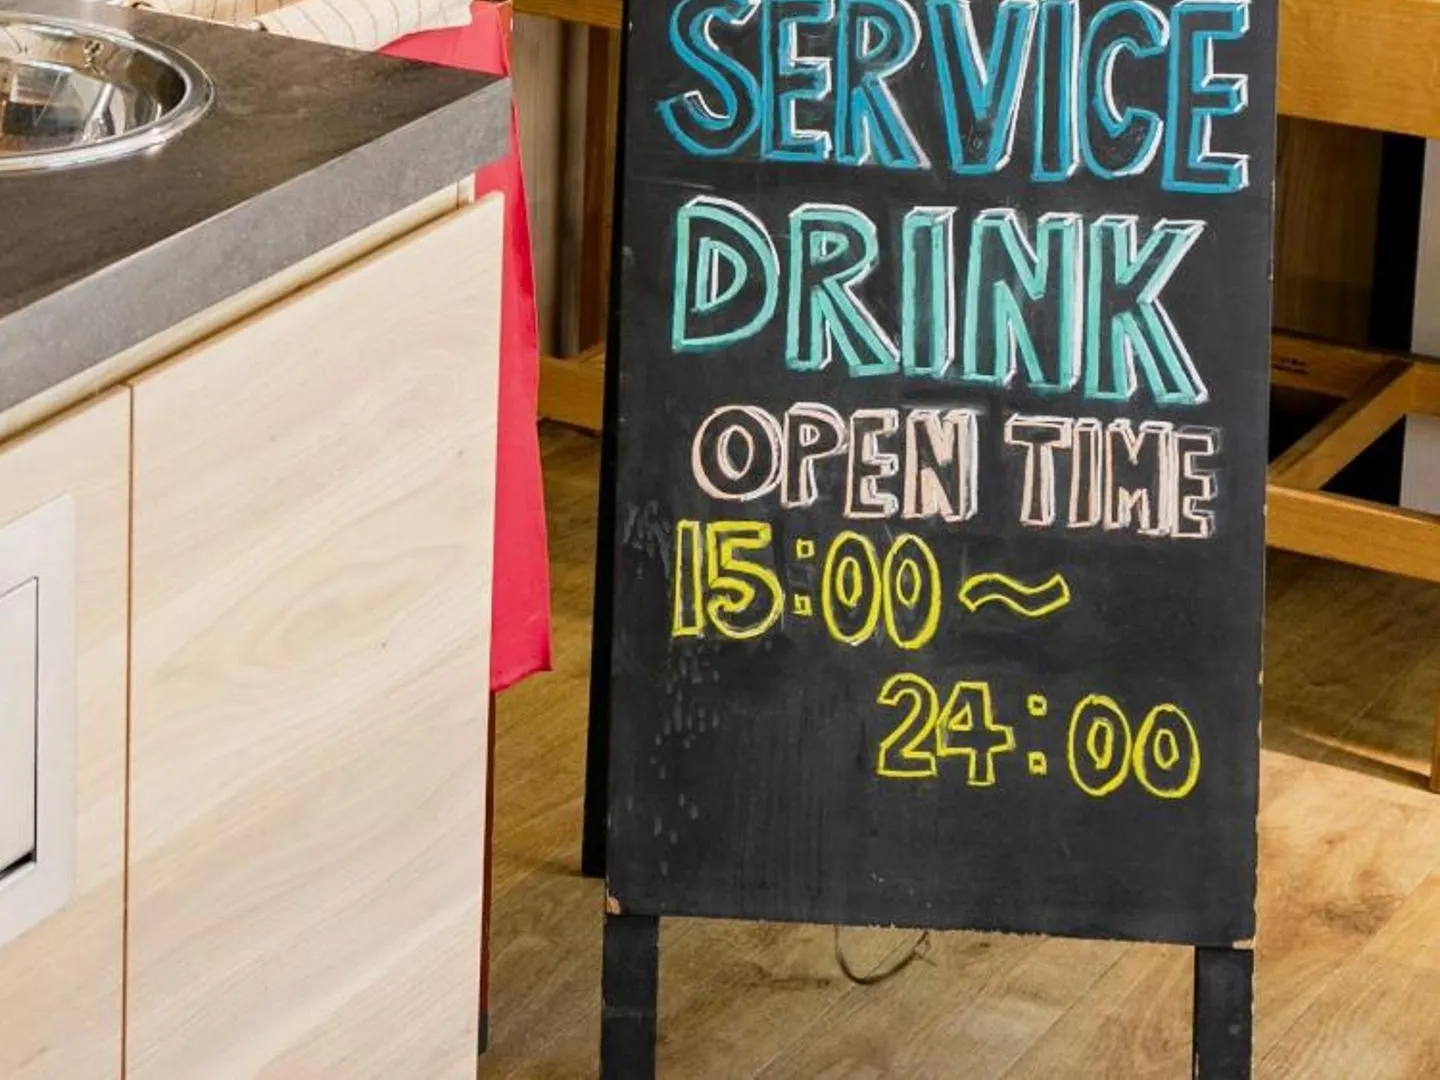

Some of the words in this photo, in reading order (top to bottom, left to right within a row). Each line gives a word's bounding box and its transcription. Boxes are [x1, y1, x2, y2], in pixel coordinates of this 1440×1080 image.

[672, 194, 1209, 405] DRINK
[691, 402, 979, 522] OPEN
[1003, 413, 1219, 538] TIME
[877, 672, 1201, 799] 24:00
